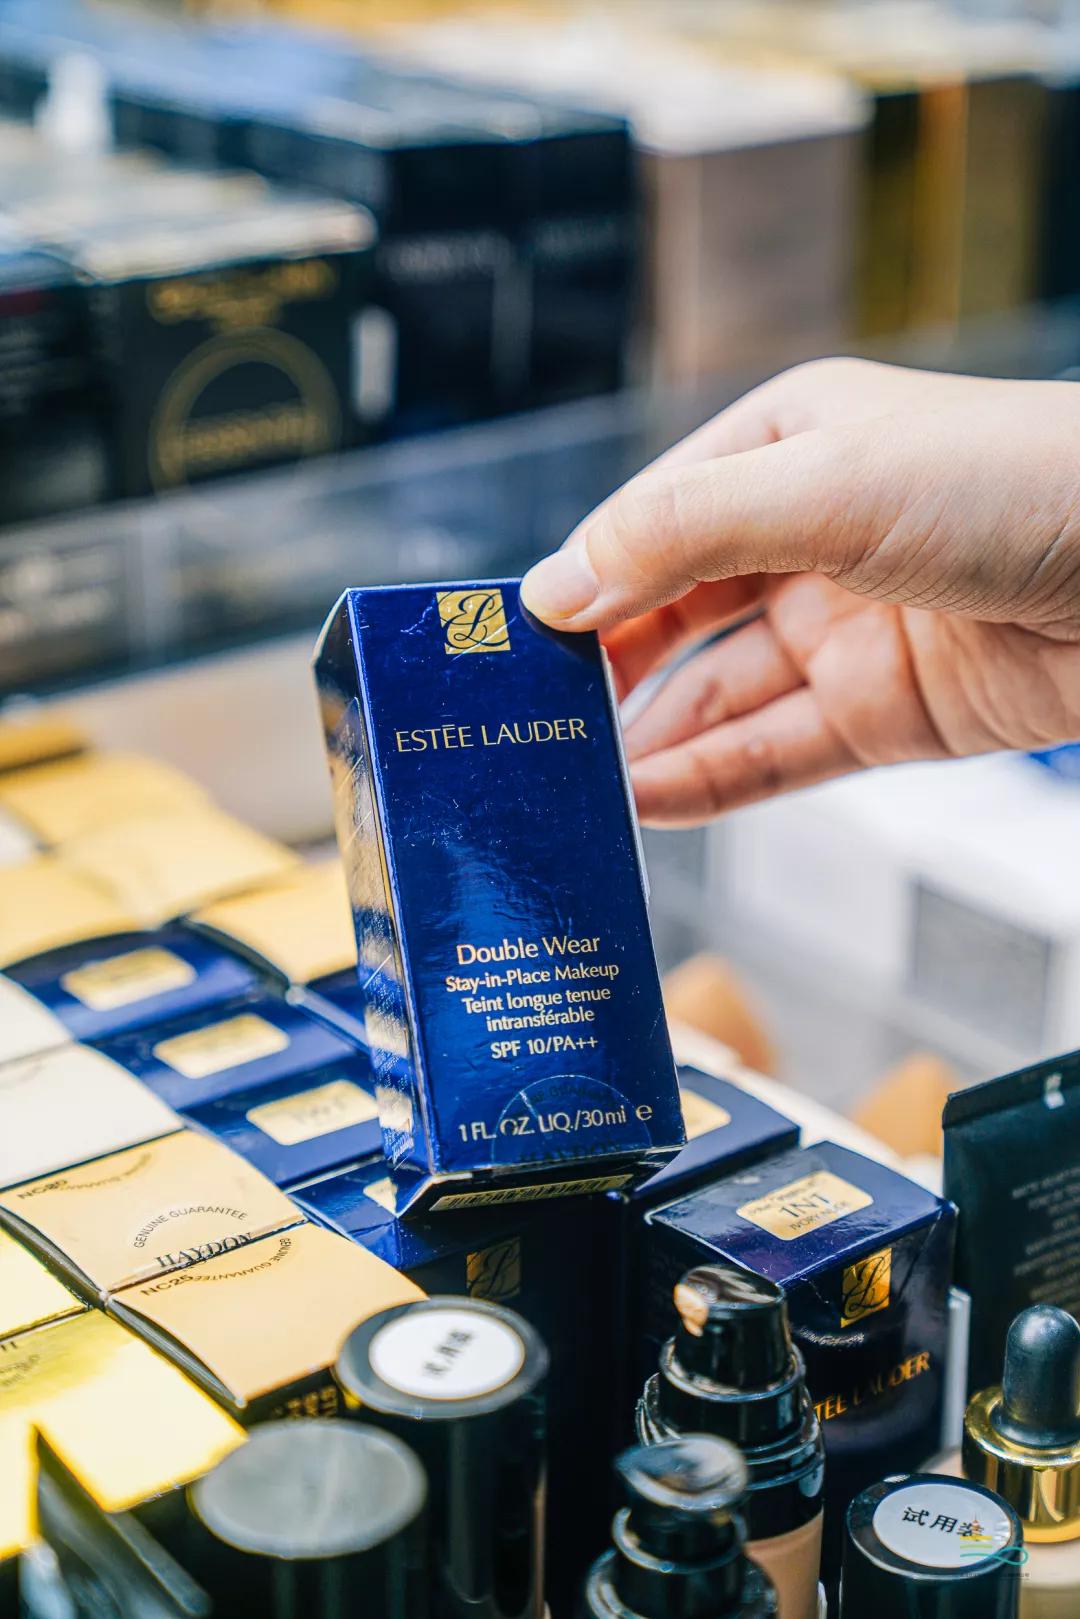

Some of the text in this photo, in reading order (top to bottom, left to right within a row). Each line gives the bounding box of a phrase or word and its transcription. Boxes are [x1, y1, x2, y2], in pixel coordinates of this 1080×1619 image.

[481, 717, 588, 746] LAUDER
[455, 935, 601, 966] Double Wear
[445, 962, 620, 994] Stay-in-Place Makeup
[462, 987, 612, 1014] Teint longue tenue
[486, 1006, 596, 1032] intransférable
[490, 1035, 599, 1060] SPF 10/PA++
[458, 1123, 468, 1143] 1
[472, 1120, 498, 1141] FL.
[133, 1205, 249, 1249] GENUINE GUARANTEE
[155, 1231, 252, 1268] HAYDON
[140, 1273, 195, 1296] NC25
